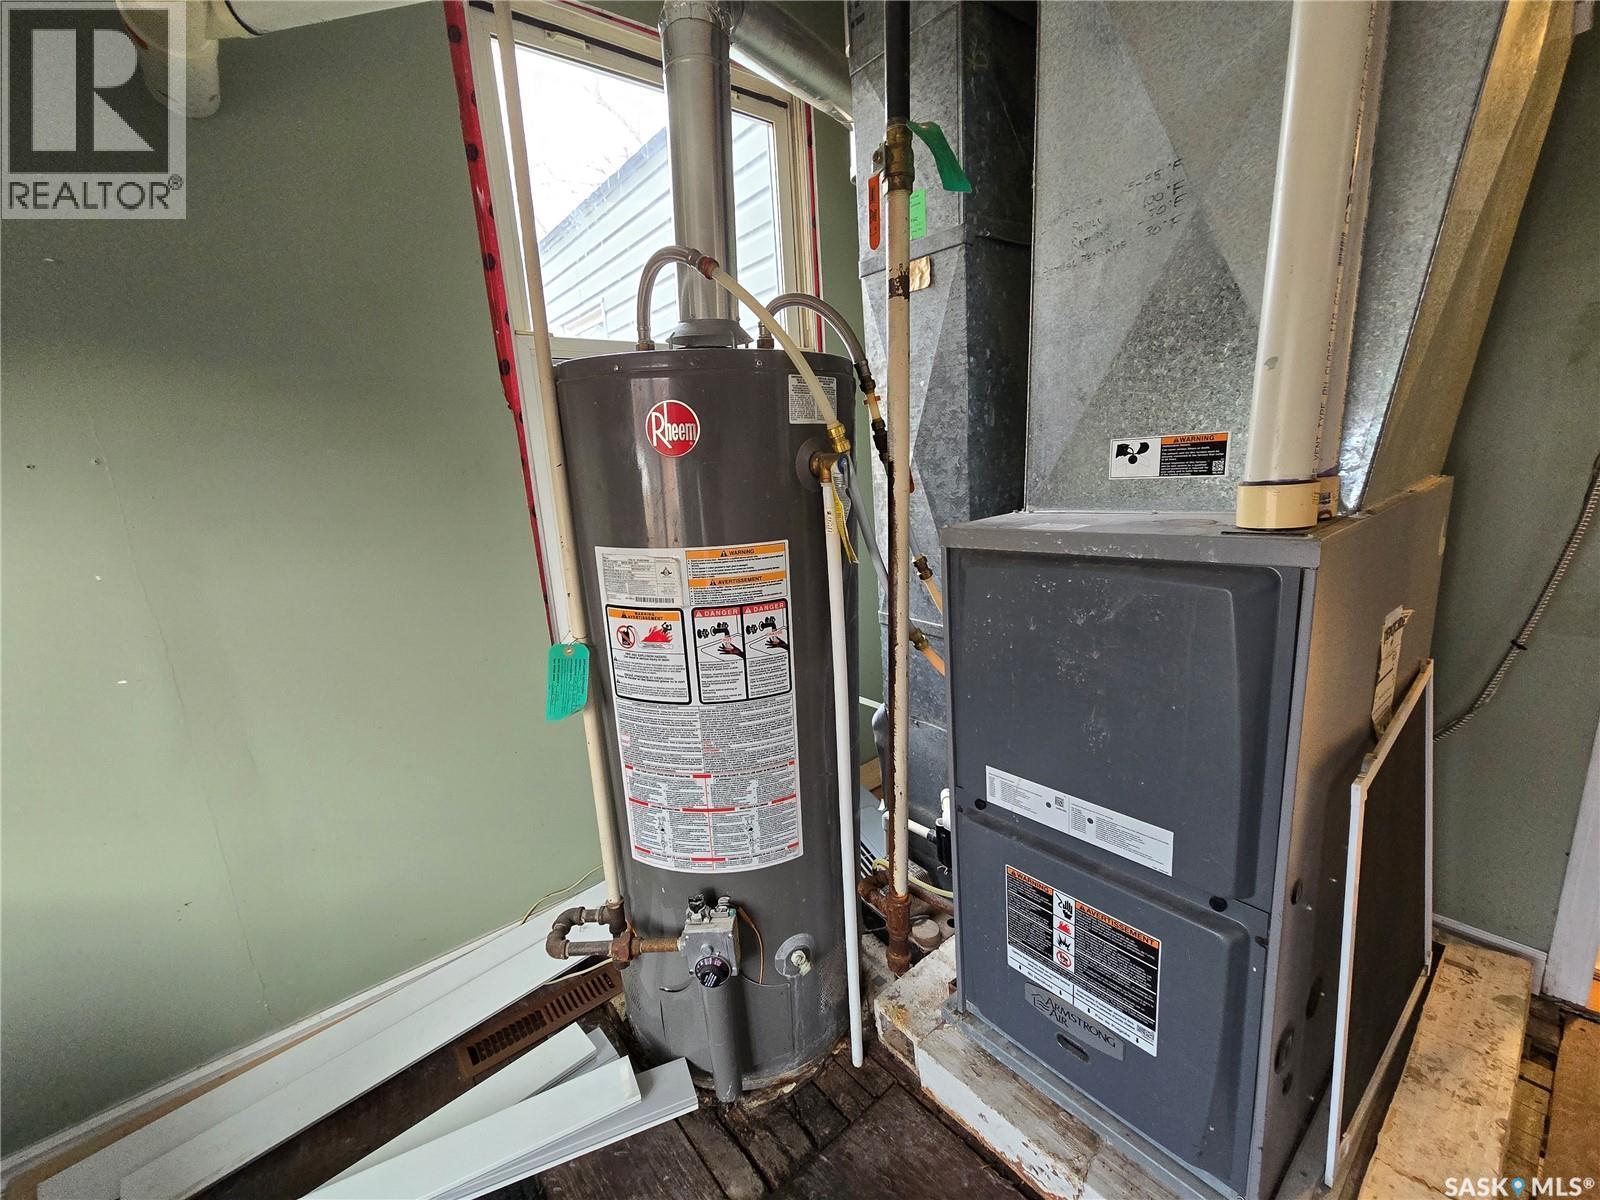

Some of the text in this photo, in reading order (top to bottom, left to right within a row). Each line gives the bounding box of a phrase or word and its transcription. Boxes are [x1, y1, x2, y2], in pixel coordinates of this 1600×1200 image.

[651, 402, 696, 449] Rheem
[1179, 434, 1215, 443] WARNING
[729, 548, 755, 556] WARNING
[718, 576, 763, 585] AVERTISSEMENT
[704, 608, 738, 616] DANGER
[753, 602, 785, 613] DANGER
[1016, 872, 1050, 894] WARNING
[1086, 907, 1156, 947] AVERTISSEMENT
[1045, 997, 1116, 1049] ARMSTRONG
[1049, 1010, 1069, 1028] AIR
